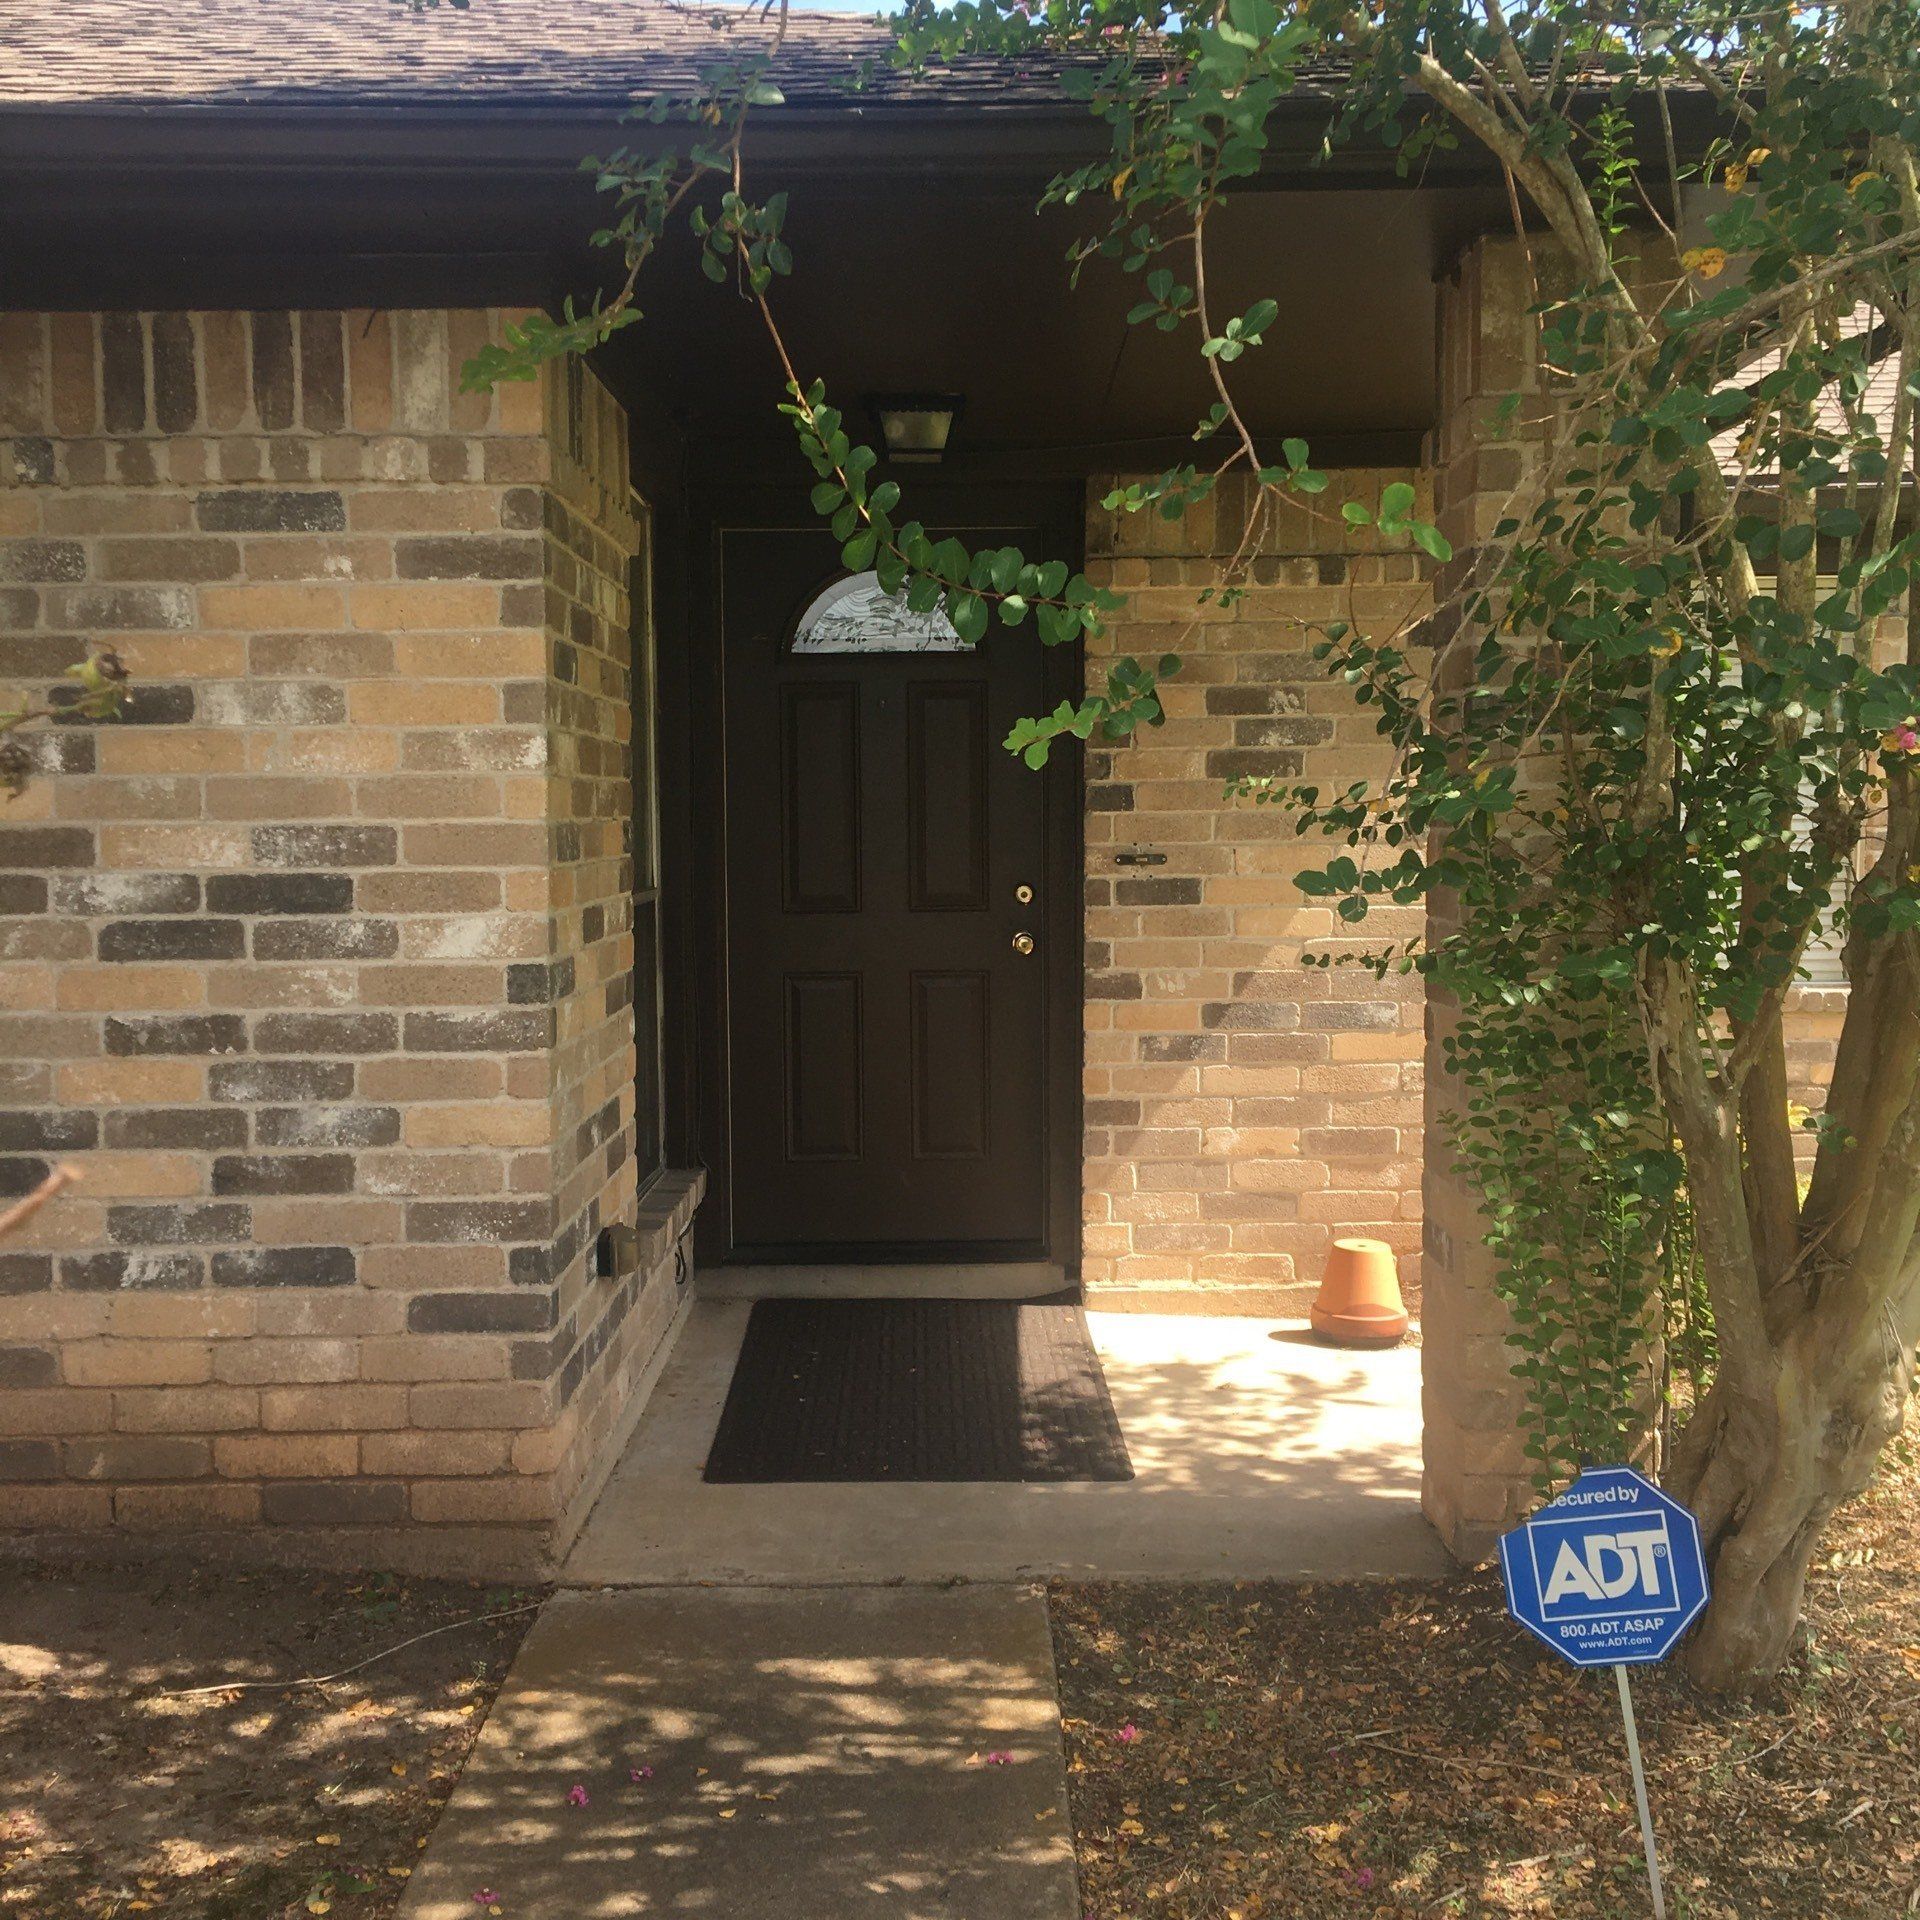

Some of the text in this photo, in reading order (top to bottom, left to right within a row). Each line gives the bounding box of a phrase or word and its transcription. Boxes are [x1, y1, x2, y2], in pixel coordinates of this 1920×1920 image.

[1617, 1485, 1640, 1504] by
[1543, 1529, 1668, 1604] ADT
[1560, 1617, 1664, 1638] 800.ADT.ASAP
[1578, 1636, 1652, 1650] www.ADT.com
